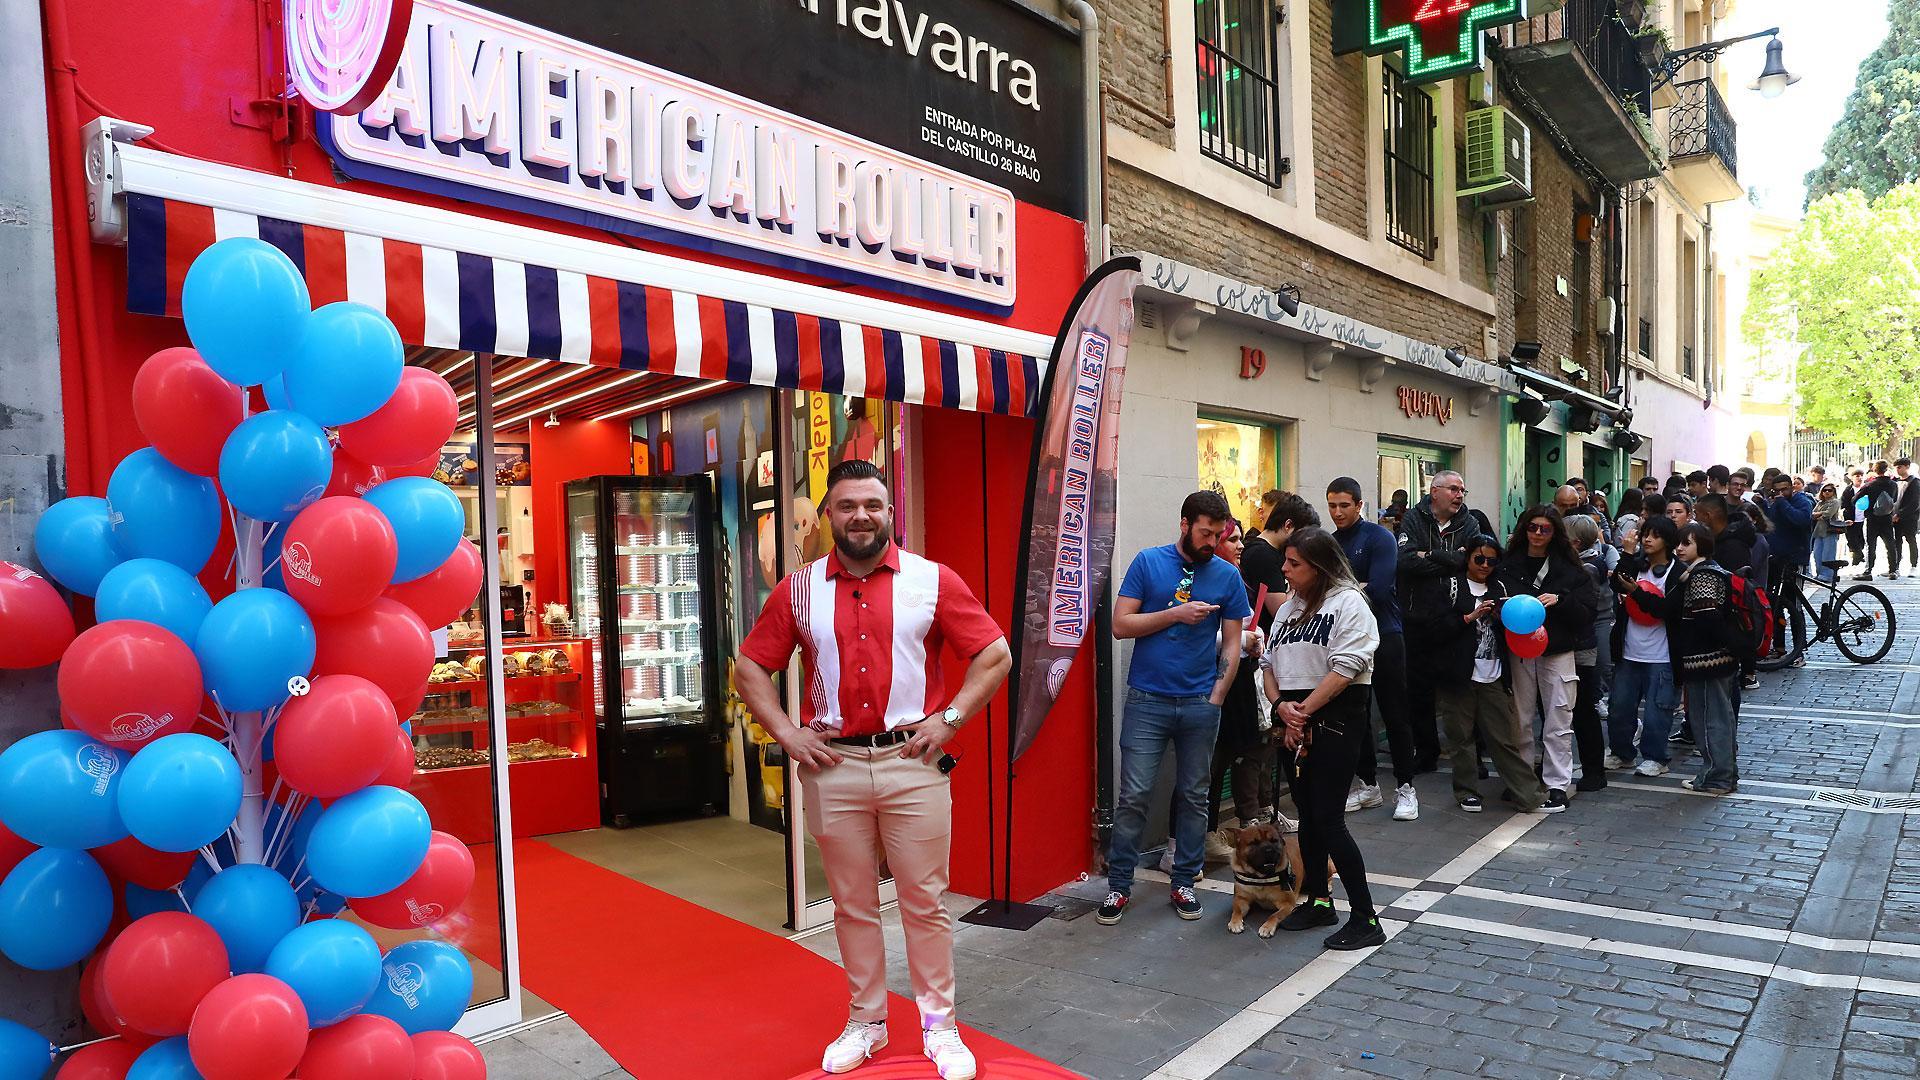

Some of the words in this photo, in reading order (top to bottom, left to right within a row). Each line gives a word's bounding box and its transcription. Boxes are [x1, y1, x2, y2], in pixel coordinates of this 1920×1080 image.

[360, 20, 798, 230] AMERICAN
[815, 144, 1010, 281] ROLLER
[921, 125, 945, 148] DEL
[946, 136, 999, 167] CASTILLO
[1001, 156, 1013, 173] 26
[1014, 161, 1041, 183] BAJO
[925, 105, 979, 140] ENTRADA
[980, 127, 1003, 149] POR
[1005, 137, 1037, 163] PLAZA
[1151, 262, 1190, 293] el
[1216, 283, 1286, 322] color
[1301, 309, 1329, 334] es
[1332, 318, 1383, 349] vida
[1069, 337, 1106, 462] ROLLER
[1238, 345, 1267, 380] 19
[1054, 467, 1088, 639] AMERICAN
